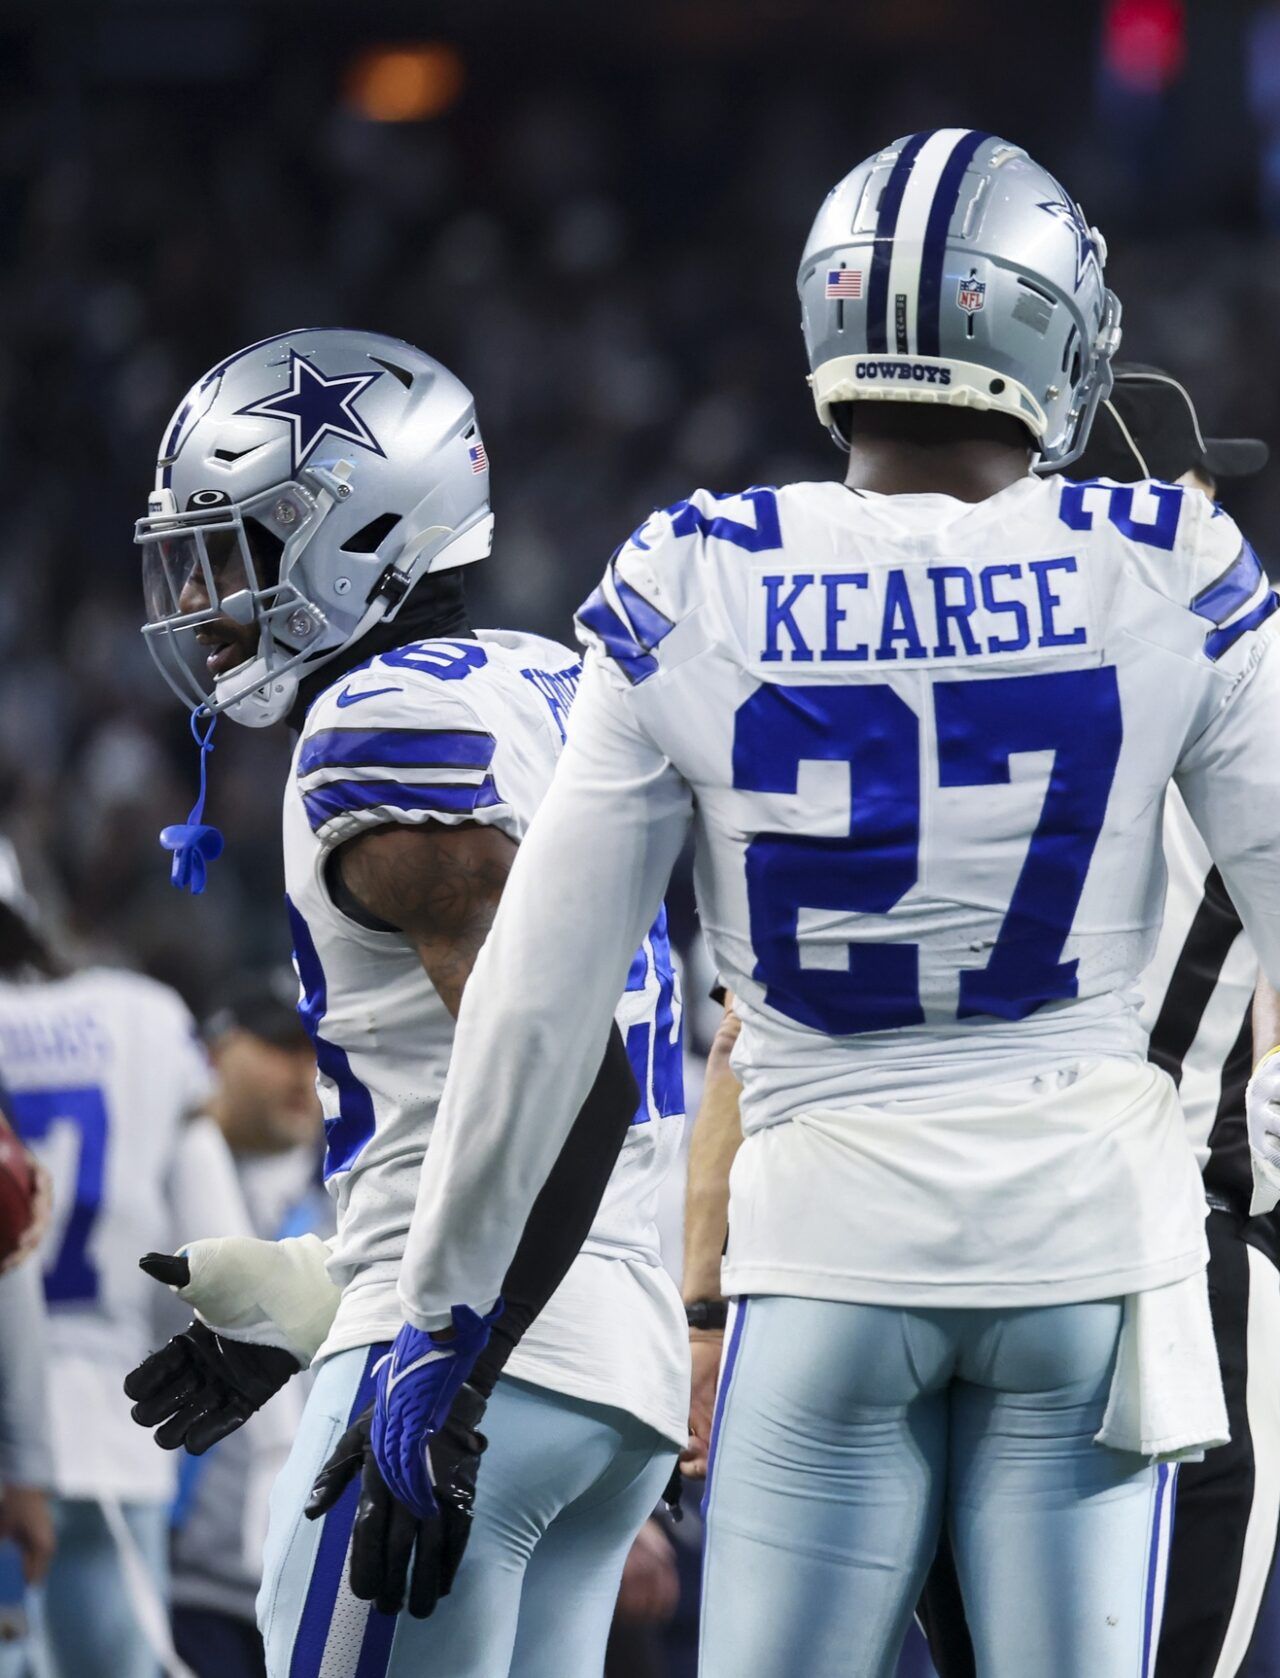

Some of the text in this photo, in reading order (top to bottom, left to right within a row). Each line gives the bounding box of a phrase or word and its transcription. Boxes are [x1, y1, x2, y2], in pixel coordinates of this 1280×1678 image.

[856, 362, 951, 385] COWBOYS
[760, 556, 1087, 661] KEARSE
[732, 665, 1123, 1035] 27
[8, 1079, 109, 1308] 7
